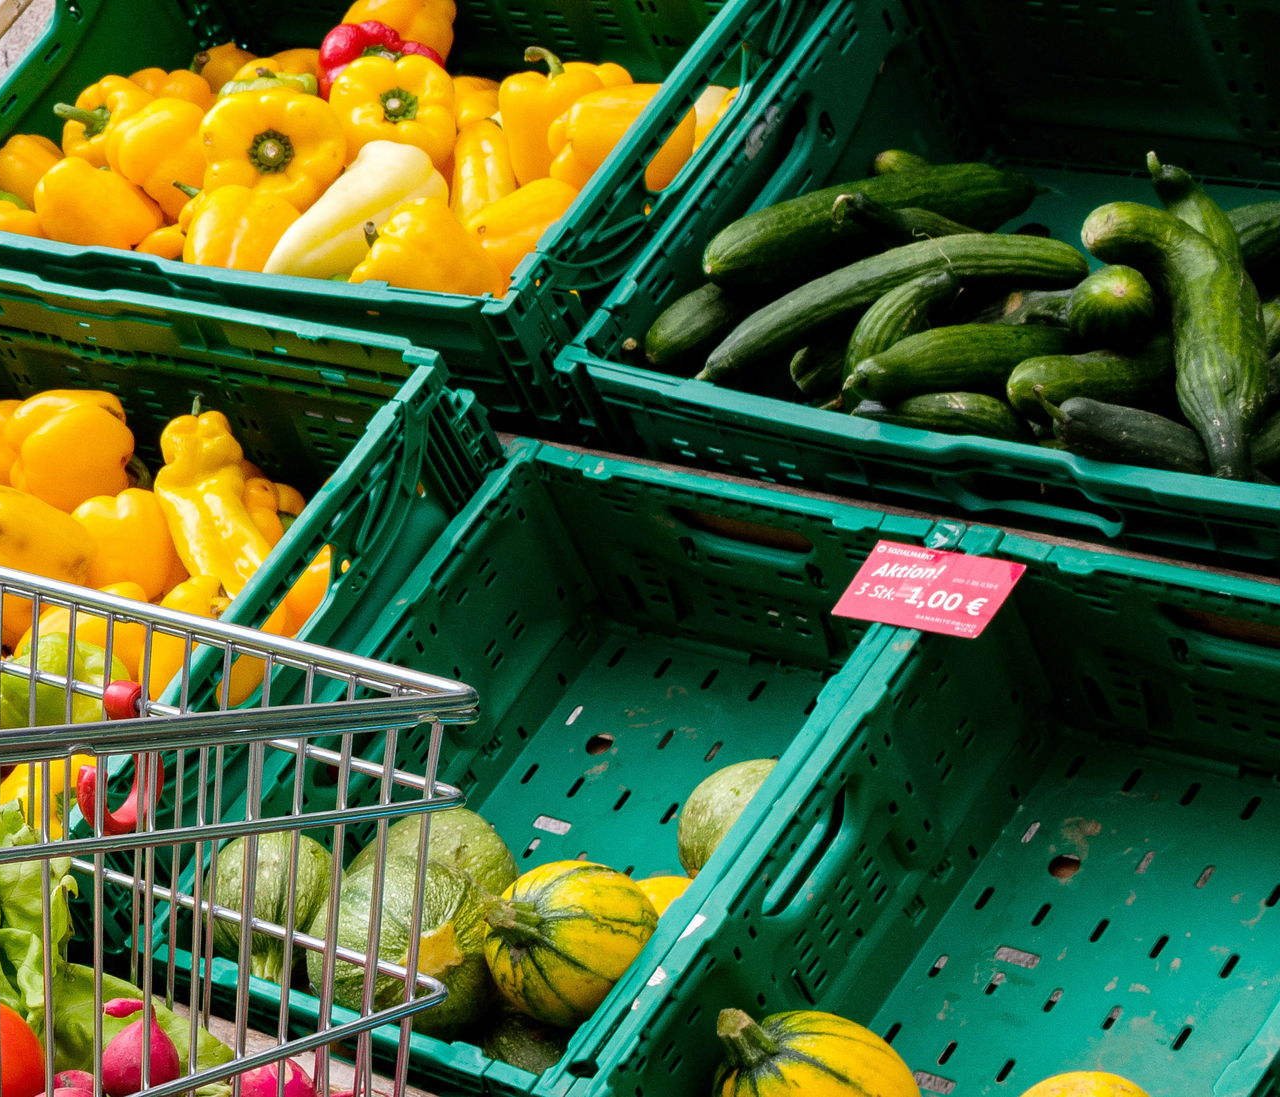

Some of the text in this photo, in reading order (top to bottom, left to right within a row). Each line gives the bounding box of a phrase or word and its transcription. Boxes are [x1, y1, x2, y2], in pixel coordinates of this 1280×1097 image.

[886, 547, 936, 561] SOZIALMARKT
[870, 562, 947, 580] Aktion!
[854, 582, 989, 616] 3 Stk. 1,00 €
[914, 613, 977, 628] SAMARITERBUND
